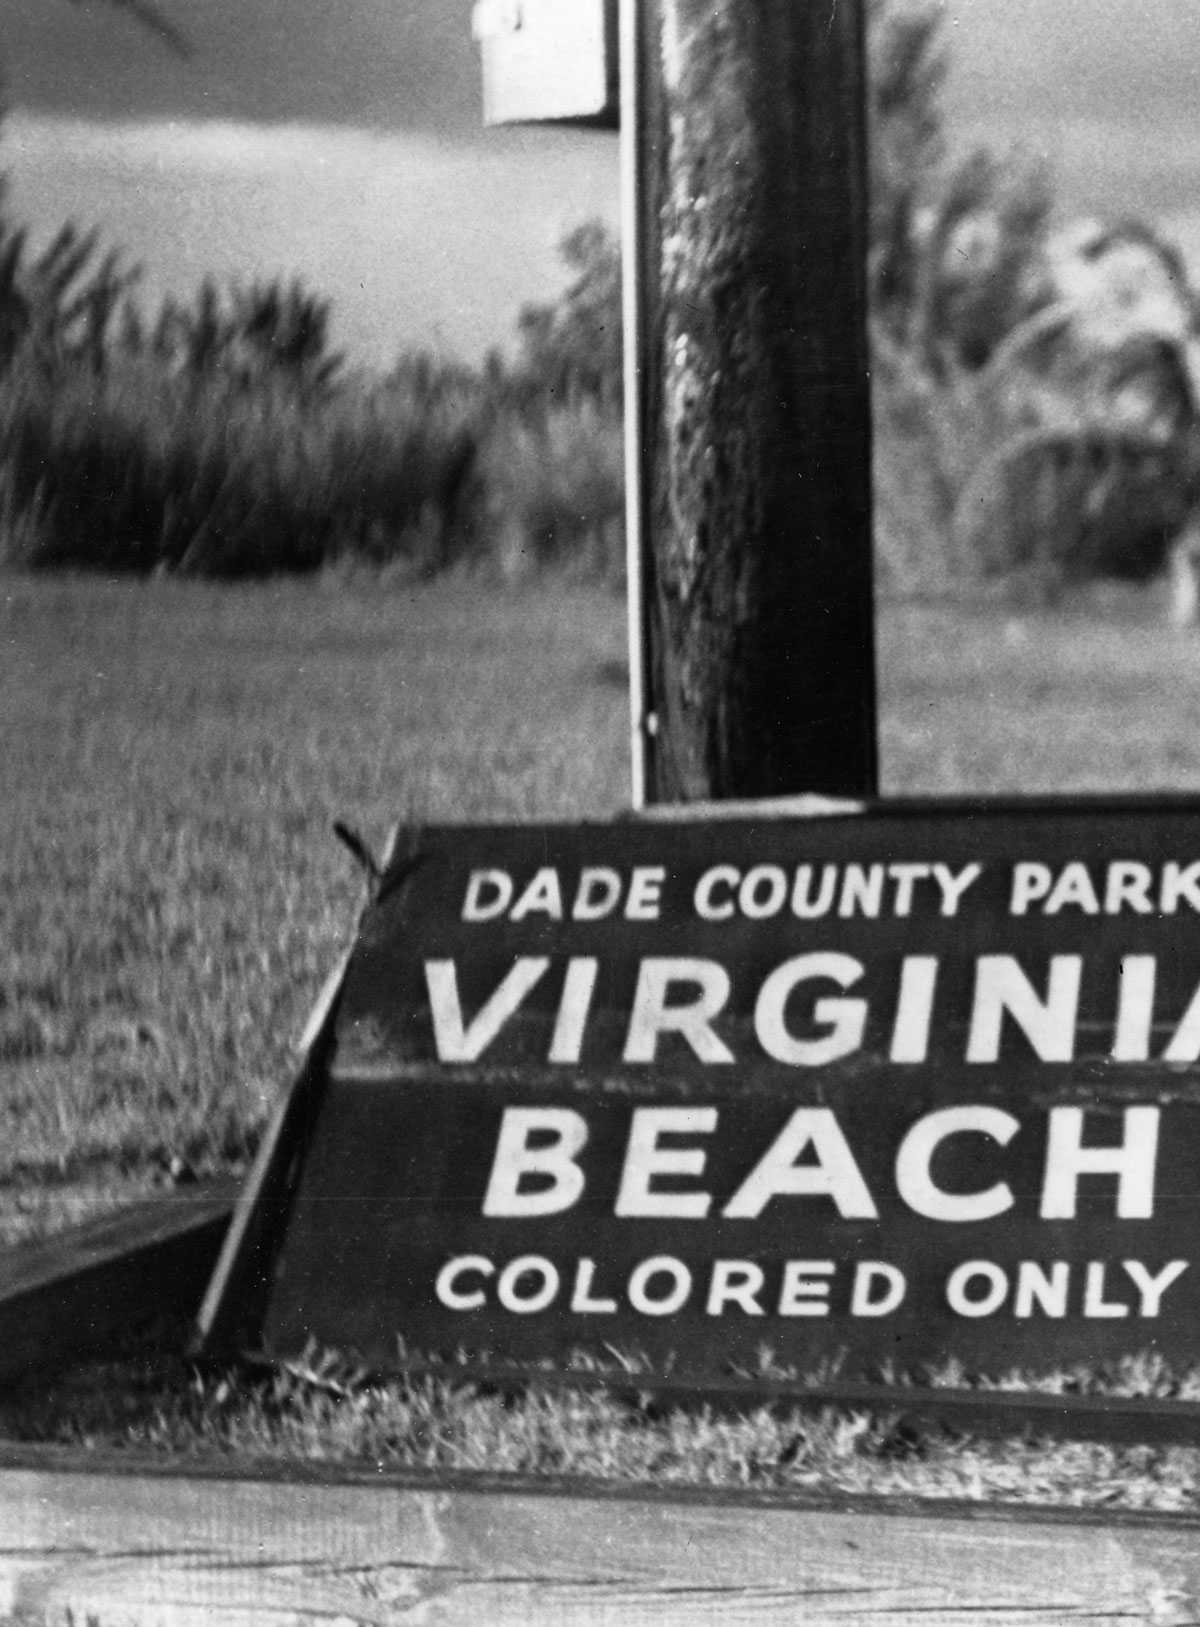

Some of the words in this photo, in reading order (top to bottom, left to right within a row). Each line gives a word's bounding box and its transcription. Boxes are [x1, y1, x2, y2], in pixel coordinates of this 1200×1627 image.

[462, 867, 666, 921] DADE
[694, 863, 981, 919] COUNTY
[482, 1106, 1161, 1222] BEACH
[436, 1255, 906, 1317] COLORED
[946, 1259, 1189, 1318] ONLY
